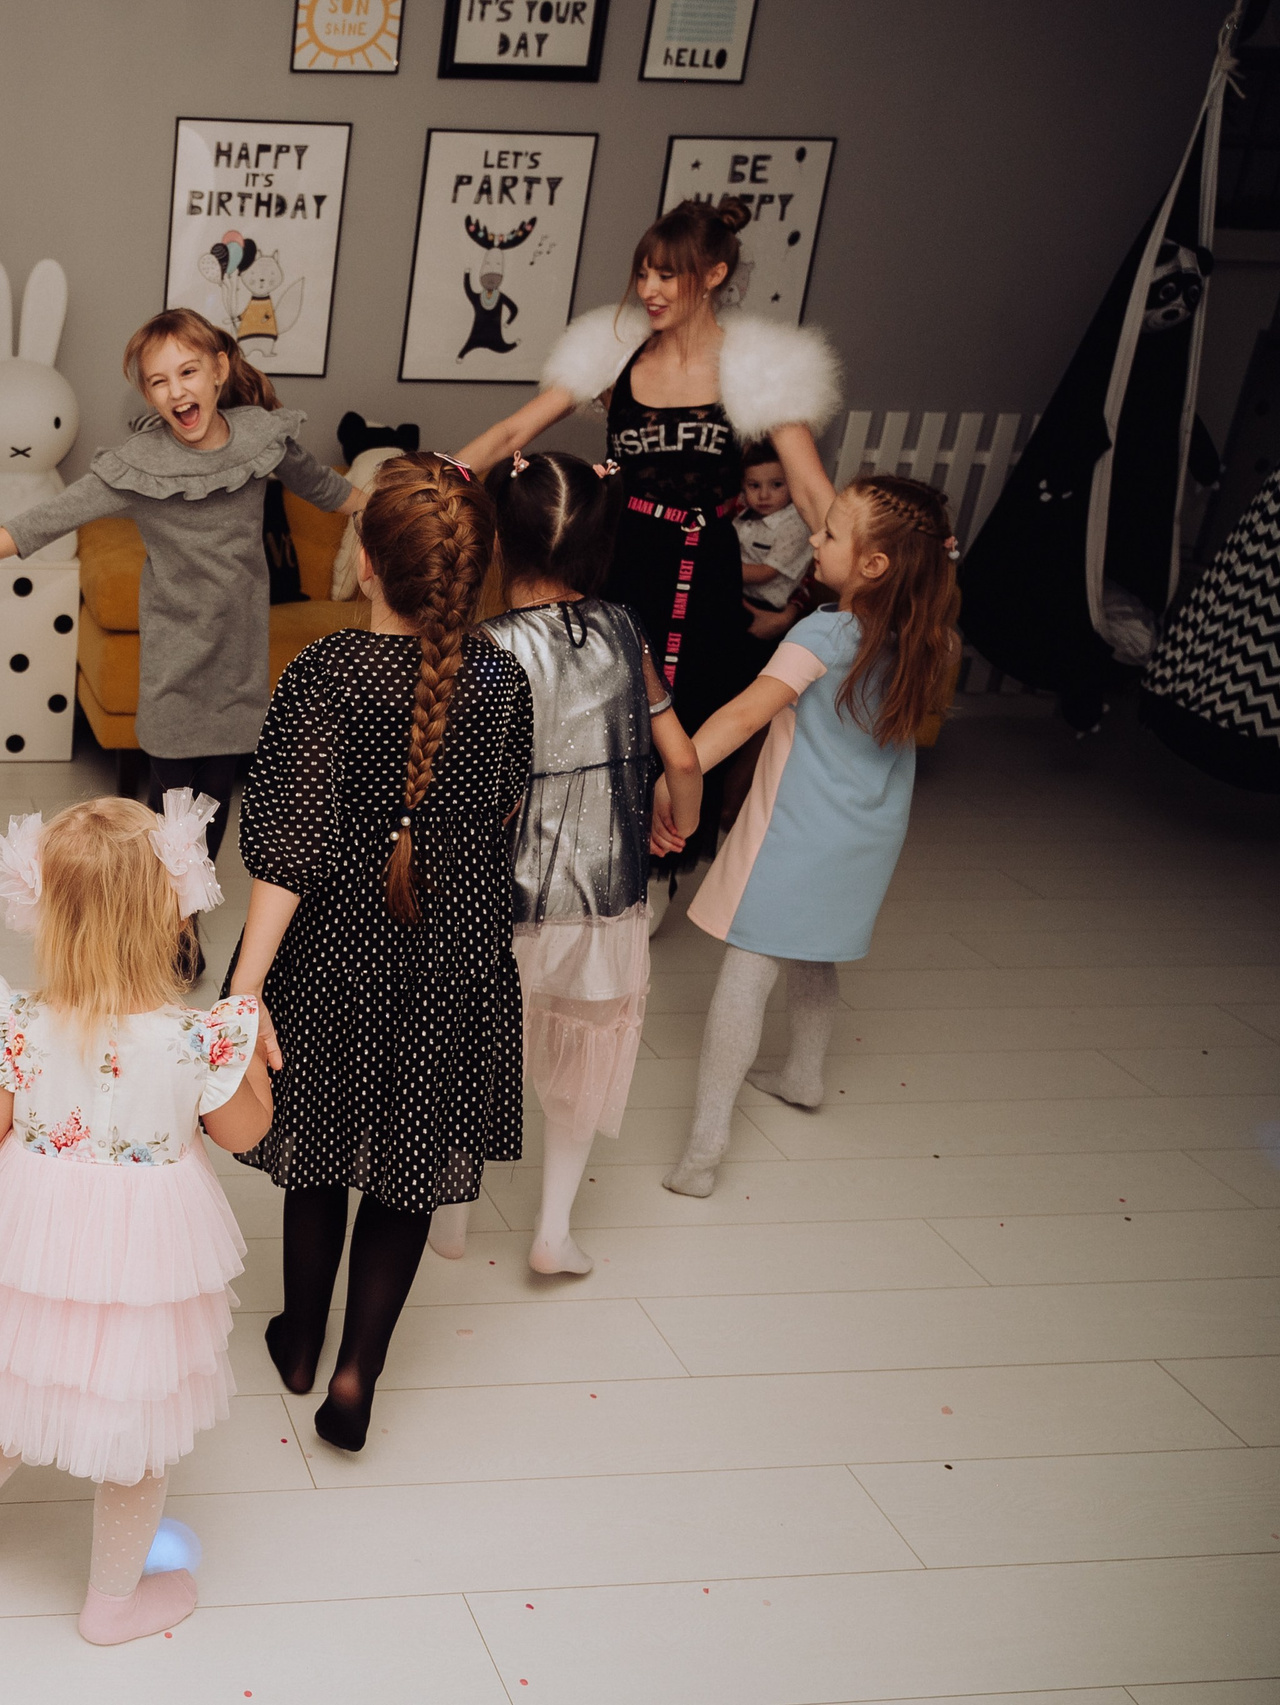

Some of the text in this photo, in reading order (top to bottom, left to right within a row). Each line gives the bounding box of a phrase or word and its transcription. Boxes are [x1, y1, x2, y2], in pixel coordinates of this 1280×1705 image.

[467, 0, 587, 24] IT'S YOUR
[497, 31, 549, 57] DAY
[214, 141, 309, 170] HAPPY
[483, 150, 542, 169] LET'S
[728, 154, 773, 184] BE
[245, 173, 275, 187] IT'S
[451, 174, 564, 206] PARTY
[186, 190, 328, 219] BIRTHDAY
[611, 421, 729, 457] #SELFIE
[627, 496, 655, 516] THANK
[663, 507, 688, 524] NEXT
[678, 559, 695, 582] NEXT
[671, 592, 689, 619] THANK
[666, 631, 682, 654] NEXT
